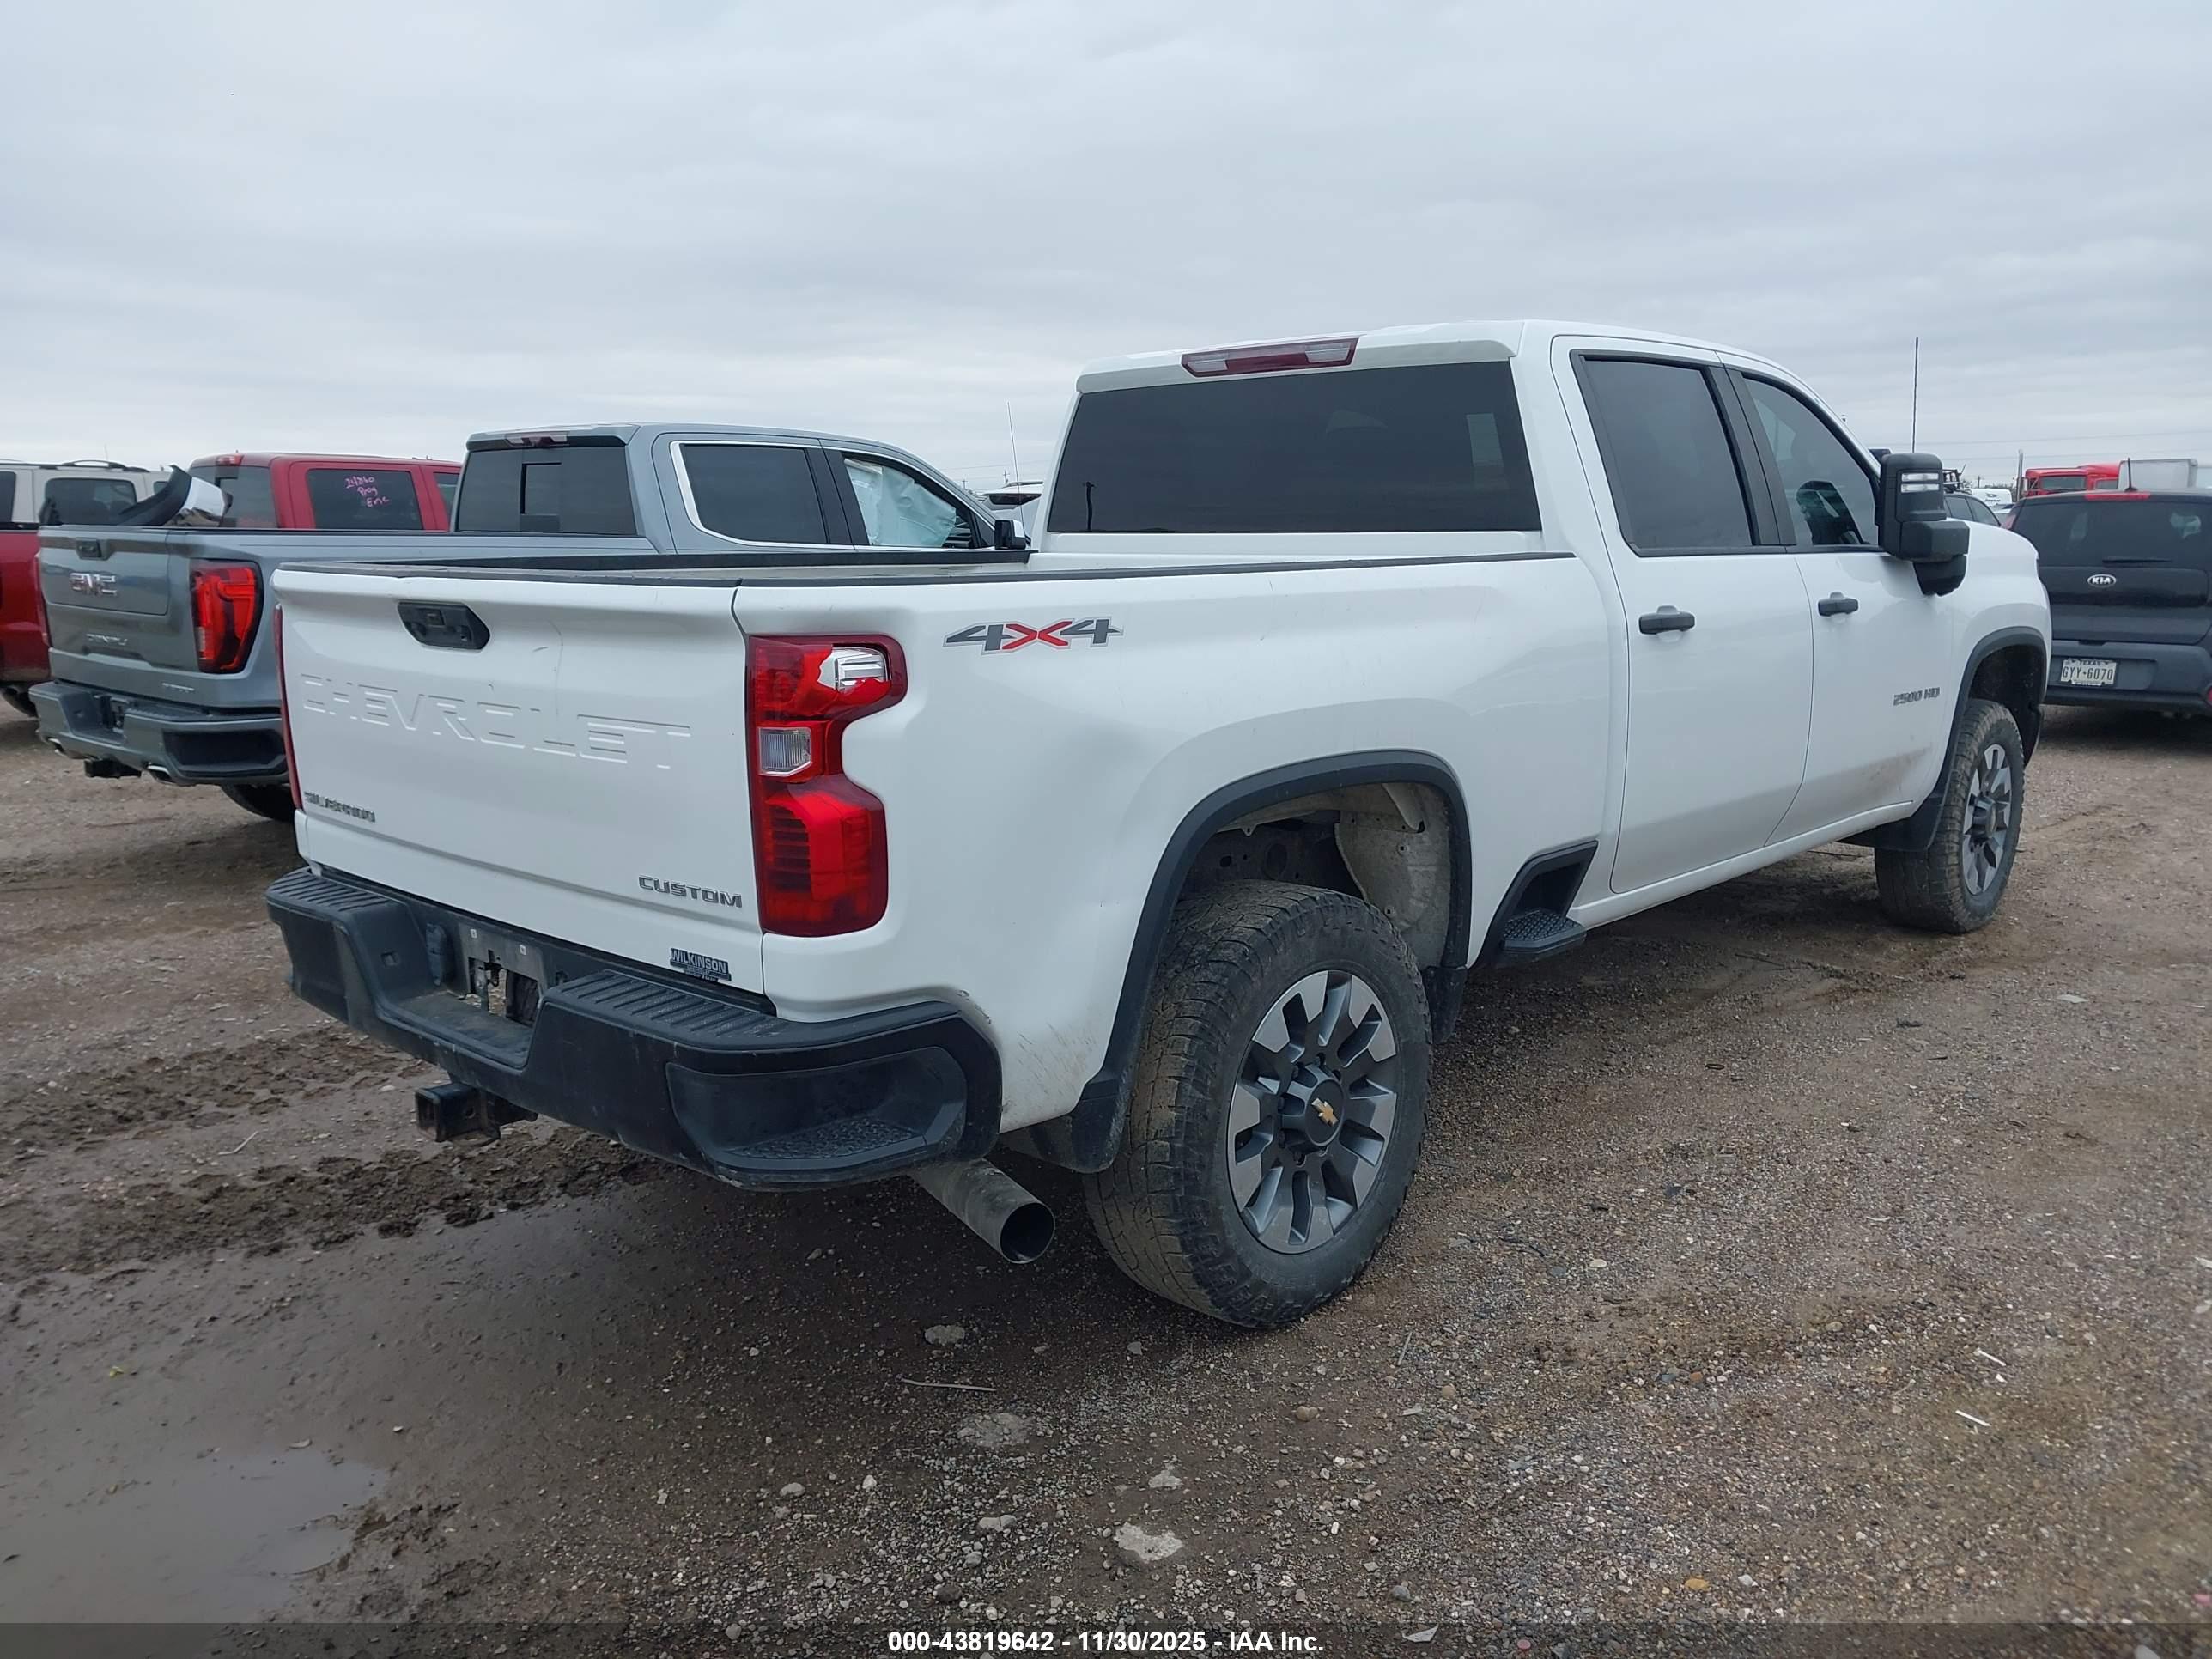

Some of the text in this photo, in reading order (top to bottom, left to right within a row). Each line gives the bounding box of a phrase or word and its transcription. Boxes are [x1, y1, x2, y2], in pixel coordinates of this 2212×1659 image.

[1893, 686, 1941, 706] 2500 HD
[301, 673, 692, 770] CHEVROLET
[638, 874, 744, 909] CUSTOM
[672, 949, 728, 975] WILKINSON
